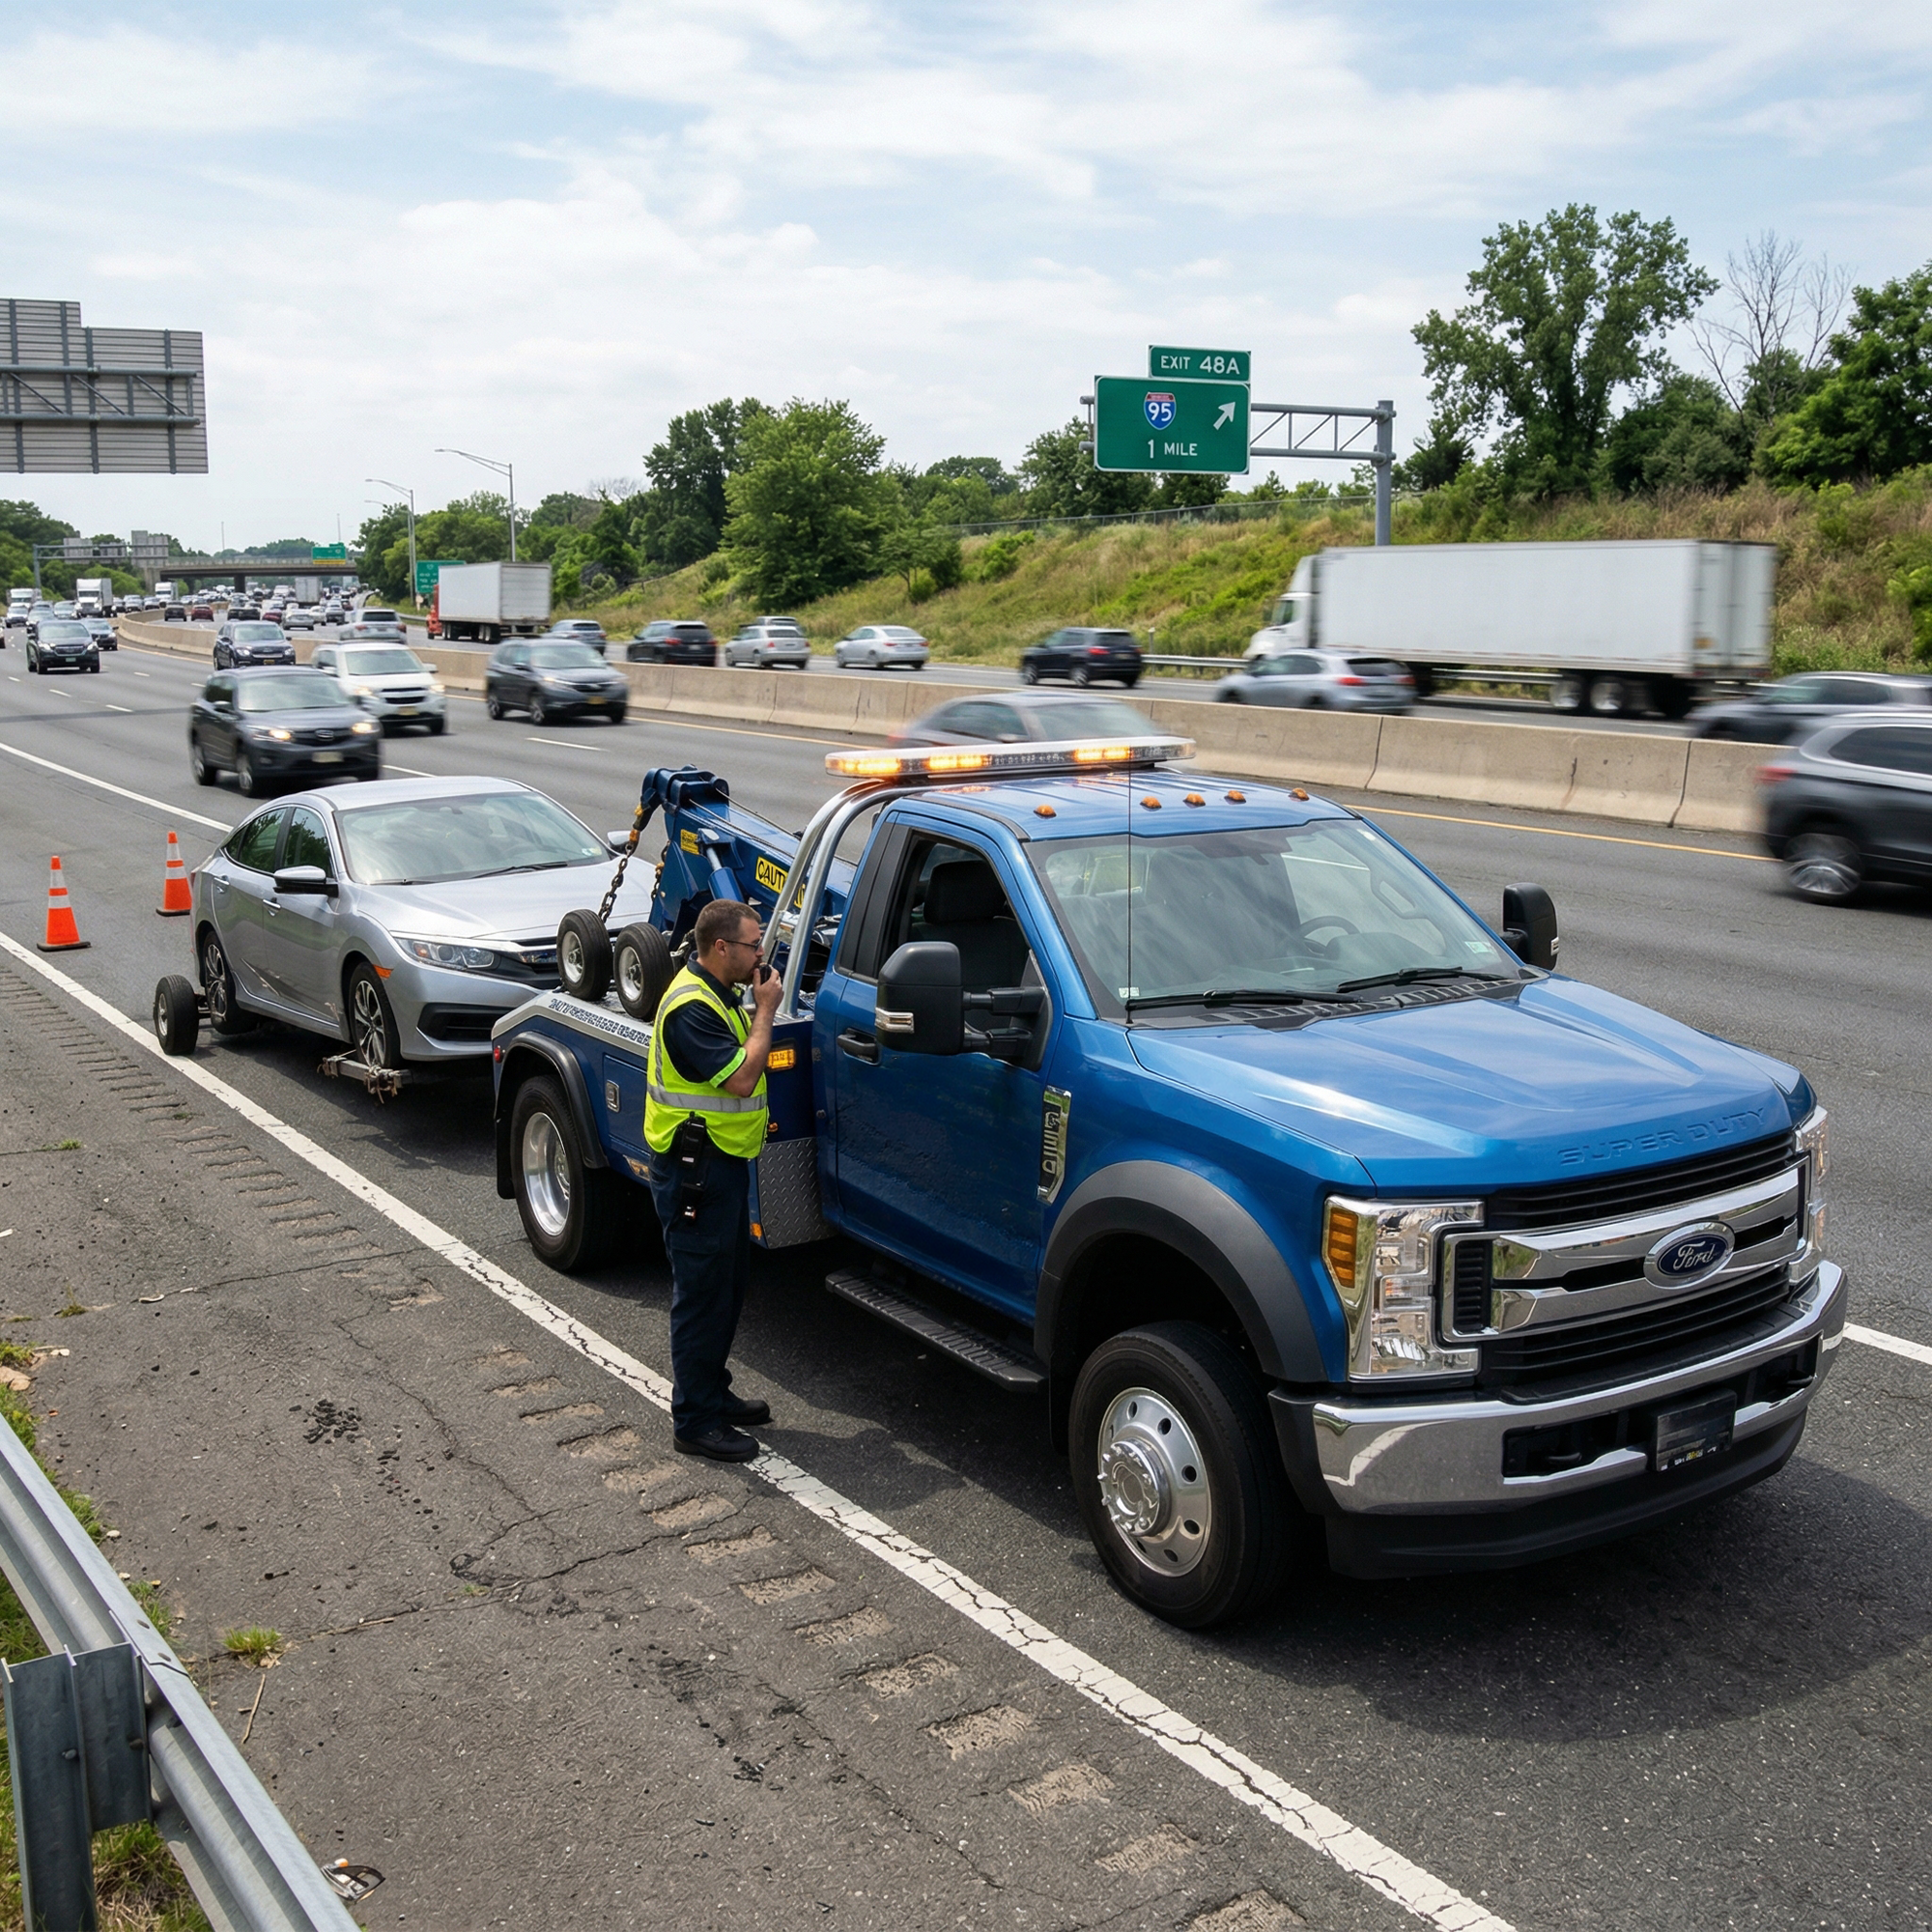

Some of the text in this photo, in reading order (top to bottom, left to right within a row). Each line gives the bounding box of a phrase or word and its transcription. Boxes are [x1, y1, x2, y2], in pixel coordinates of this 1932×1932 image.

[1160, 355, 1240, 375] EXIT 48A
[1148, 402, 1173, 422] 95
[1148, 439, 1198, 459] 1 MILE
[1557, 1107, 1765, 1167] SUPER DUTY
[1672, 1240, 1717, 1271] Ford
